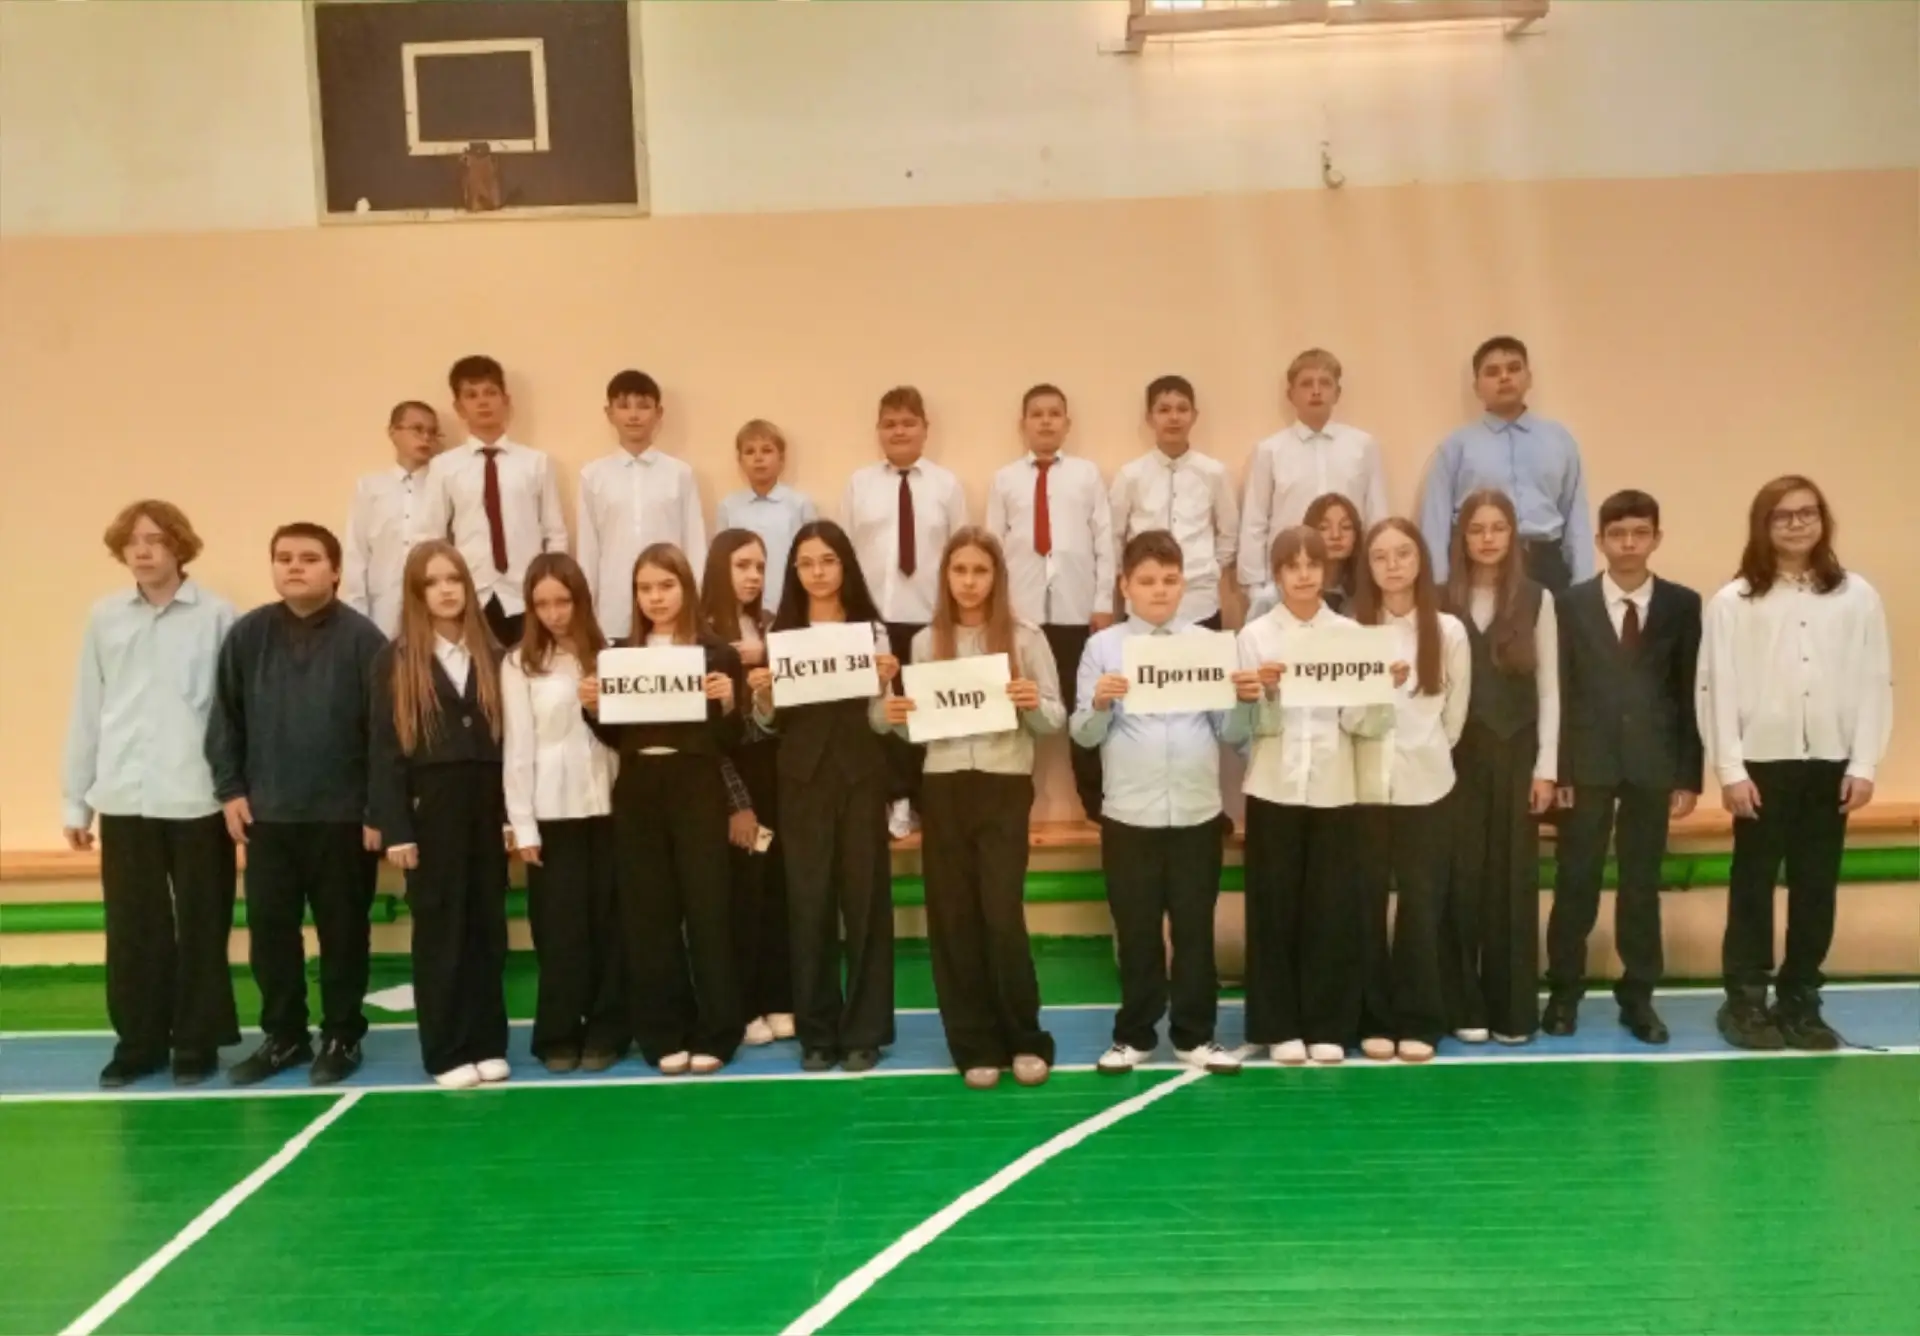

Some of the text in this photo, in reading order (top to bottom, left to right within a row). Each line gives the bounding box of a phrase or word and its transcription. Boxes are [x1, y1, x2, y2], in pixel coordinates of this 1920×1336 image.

[774, 653, 871, 682] Дети за
[1137, 664, 1225, 688] Против
[1294, 659, 1385, 682] террора
[600, 675, 703, 695] БЕСЛАН
[934, 688, 986, 709] Мир
